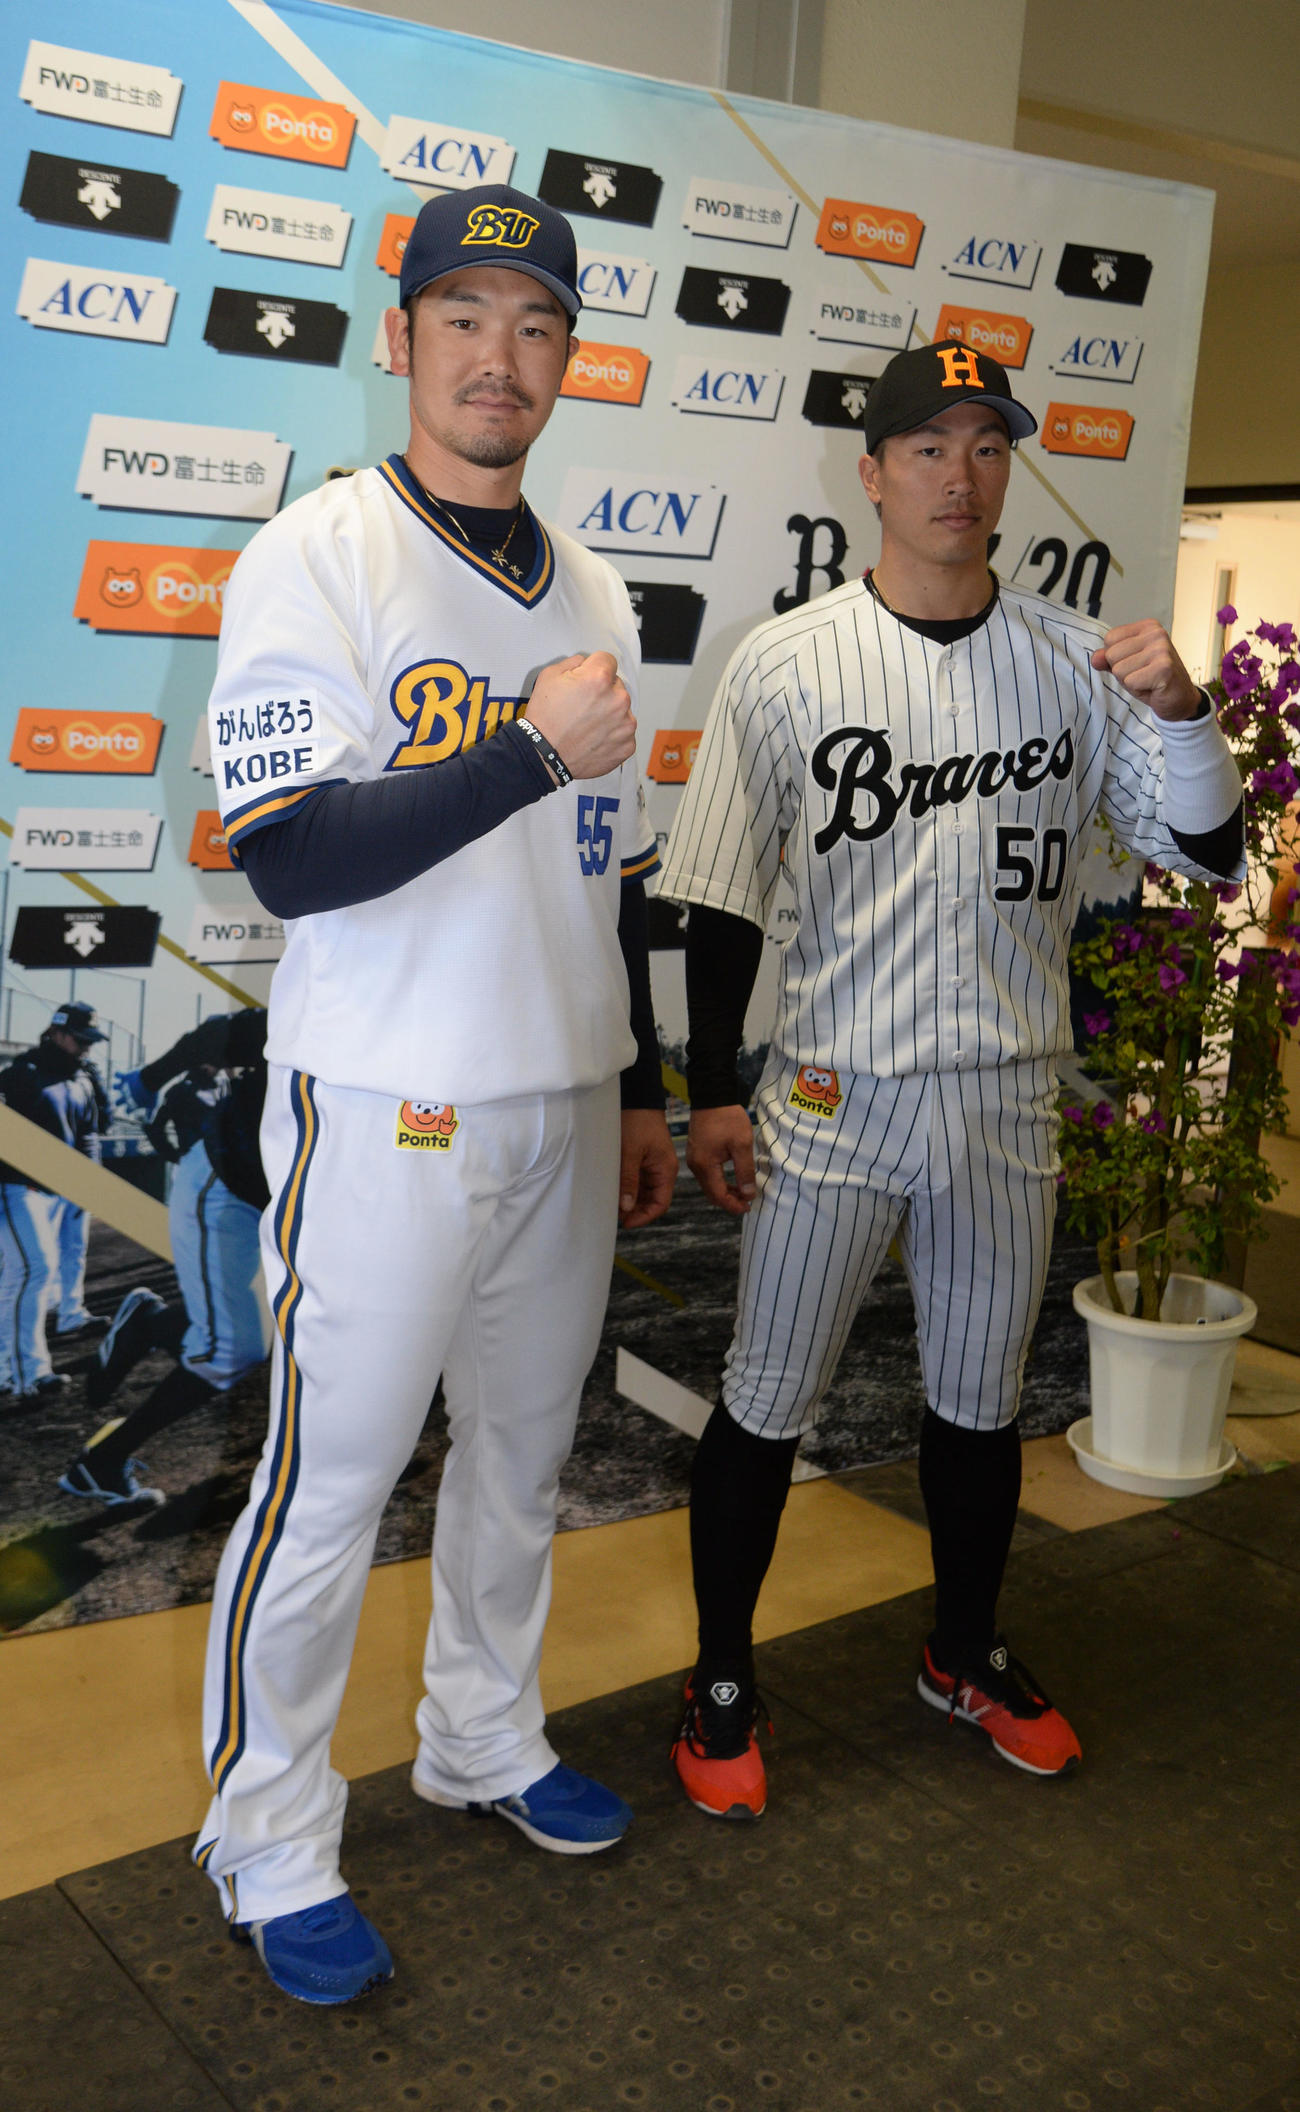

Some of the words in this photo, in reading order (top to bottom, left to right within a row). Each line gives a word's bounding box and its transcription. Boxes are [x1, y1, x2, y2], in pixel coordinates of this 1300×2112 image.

[265, 113, 333, 142] Ponta
[400, 135, 498, 179] ACN
[856, 221, 907, 246] Ponta
[953, 236, 1027, 273] ACN
[578, 262, 638, 299] CN
[40, 279, 154, 324] ACN
[970, 325, 1017, 350] Ponta
[1060, 336, 1129, 368] ACN
[574, 359, 630, 384] Ponta
[936, 346, 985, 389] H
[684, 370, 767, 404] ACN
[1075, 420, 1120, 441] Ponta
[103, 447, 169, 476] FWD
[174, 455, 266, 487] 富士生命
[577, 487, 701, 537] ACN
[216, 699, 313, 746] がんばろう
[67, 731, 140, 753] Ponta
[224, 746, 313, 790] KOBE
[811, 726, 1074, 856] Braves
[577, 794, 620, 877] 55
[994, 826, 1067, 902] 50
[790, 1092, 834, 1117] Ponta
[399, 1132, 450, 1149] Ponta
